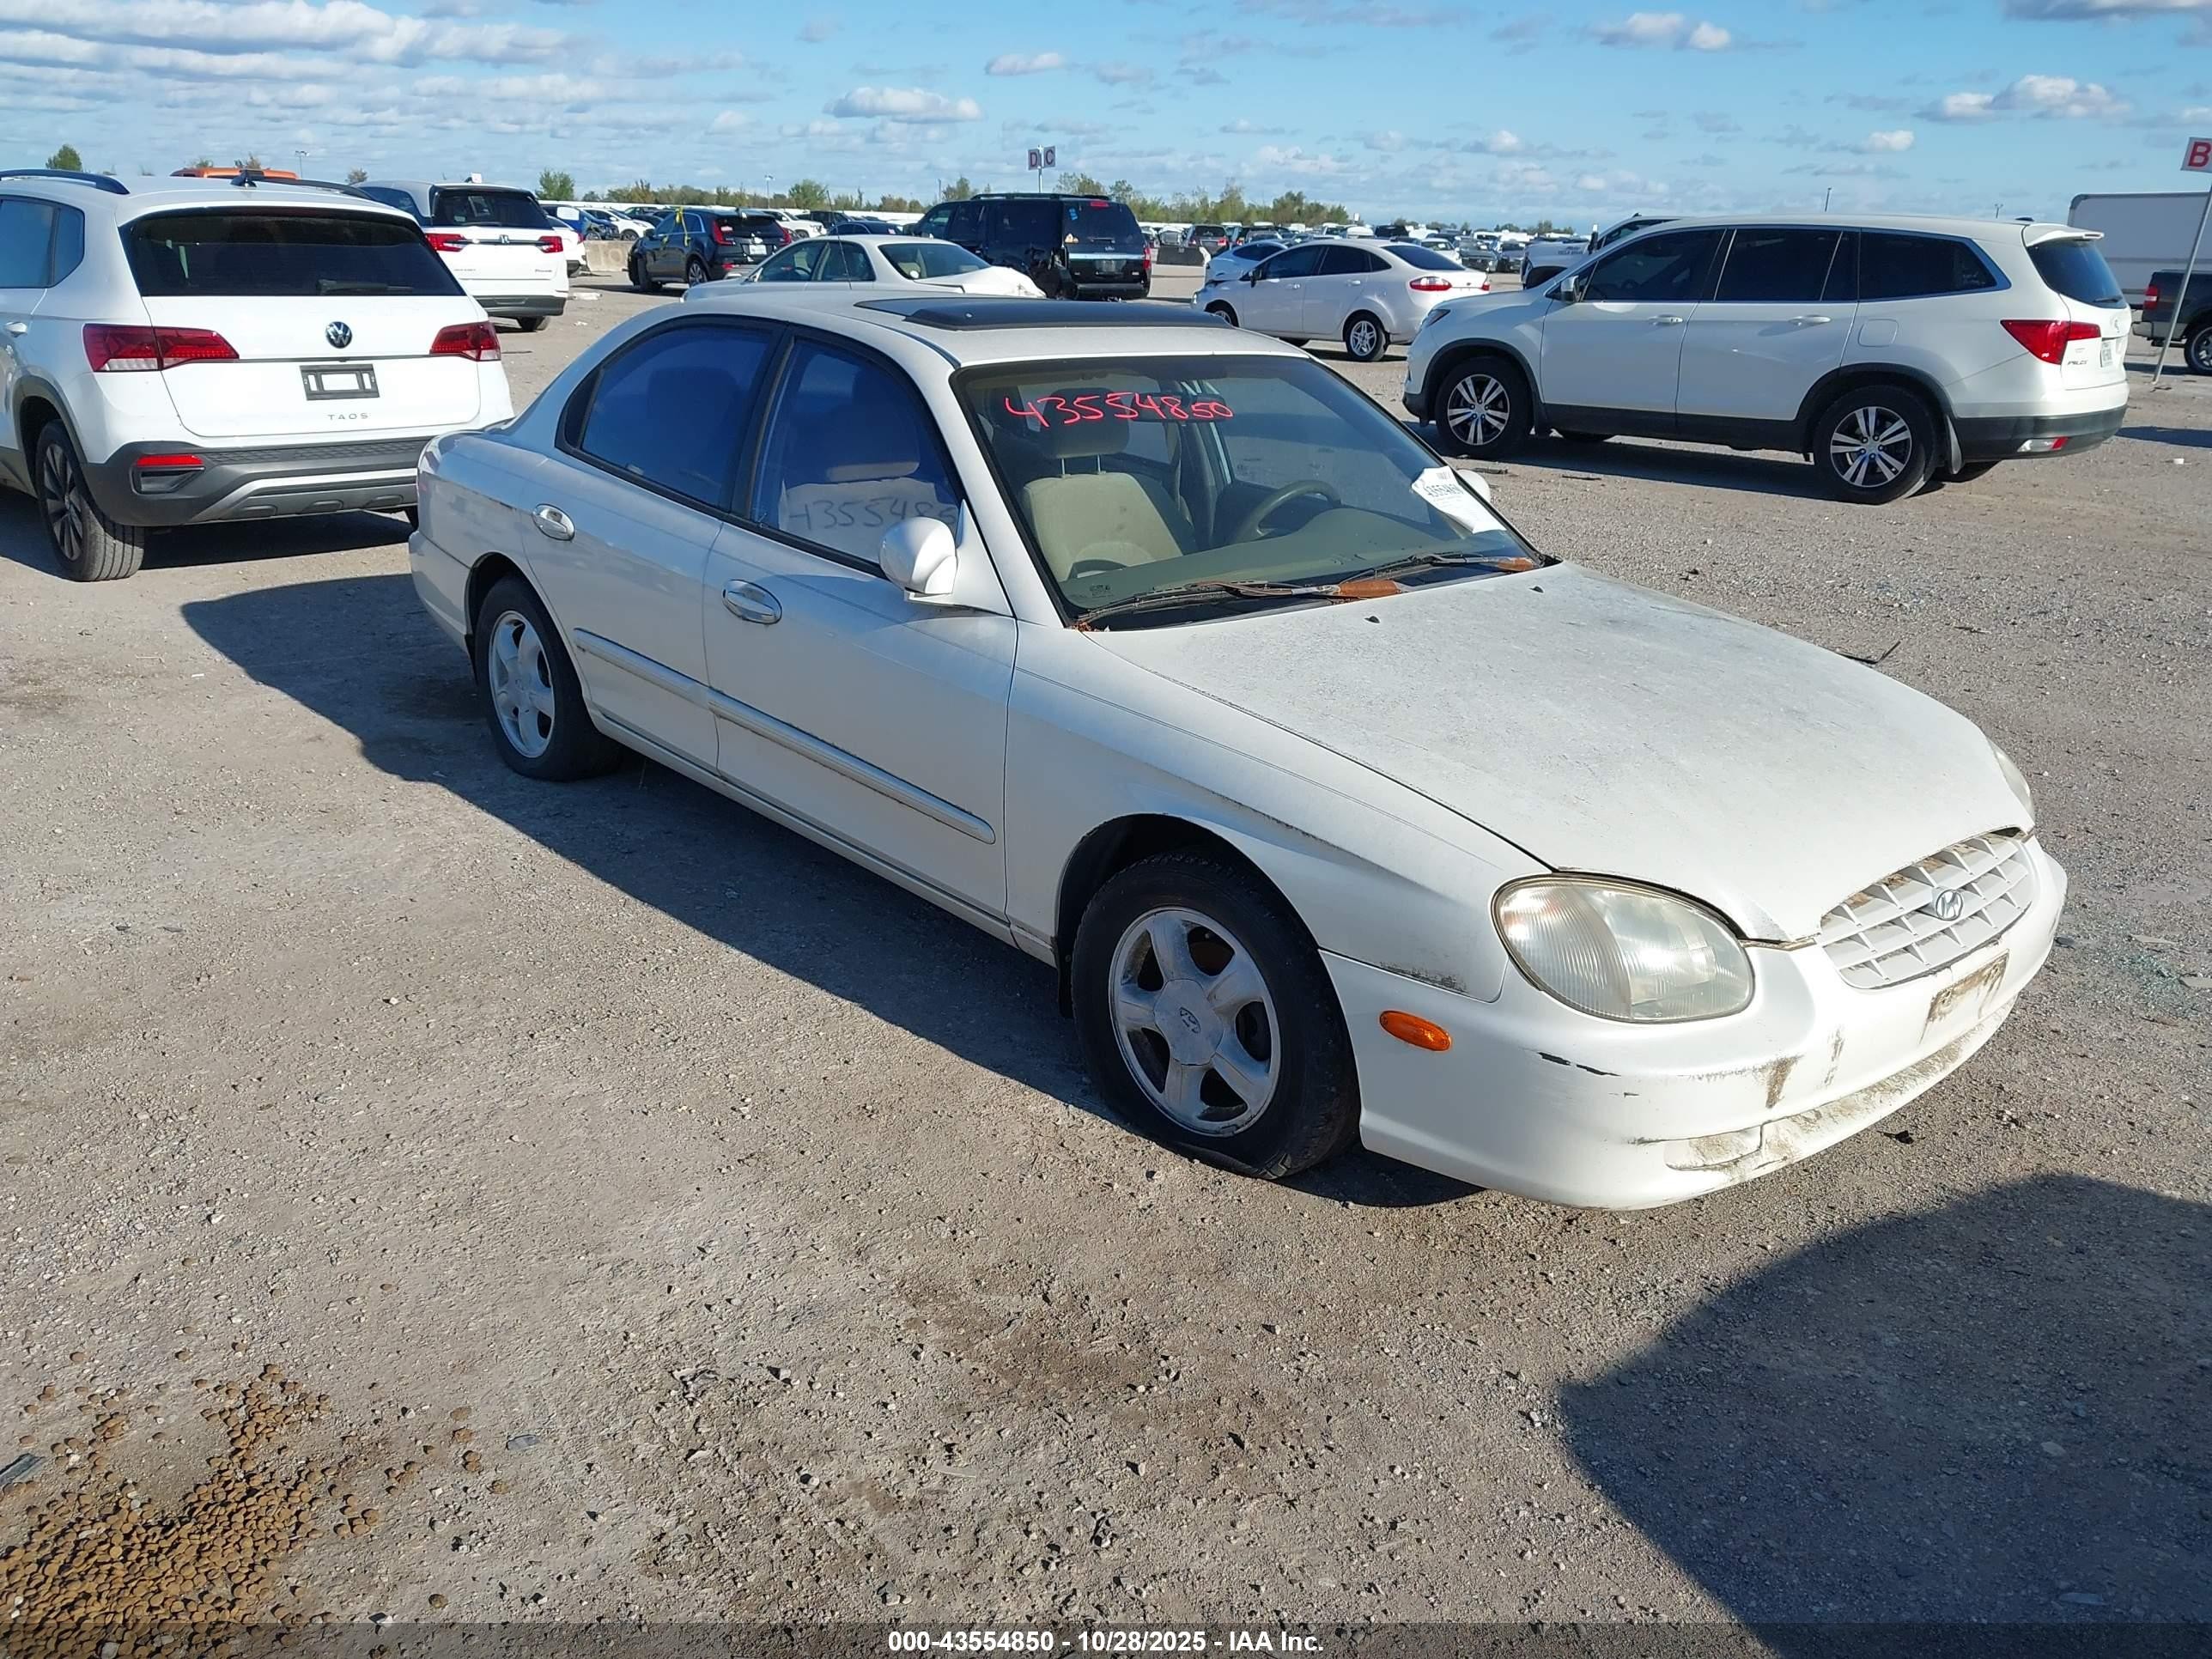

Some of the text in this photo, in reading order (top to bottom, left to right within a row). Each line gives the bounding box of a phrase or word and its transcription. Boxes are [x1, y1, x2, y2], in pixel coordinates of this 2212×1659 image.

[1030, 152, 1037, 167] D
[2188, 141, 2211, 167] B
[1005, 392, 1234, 428] 43554850
